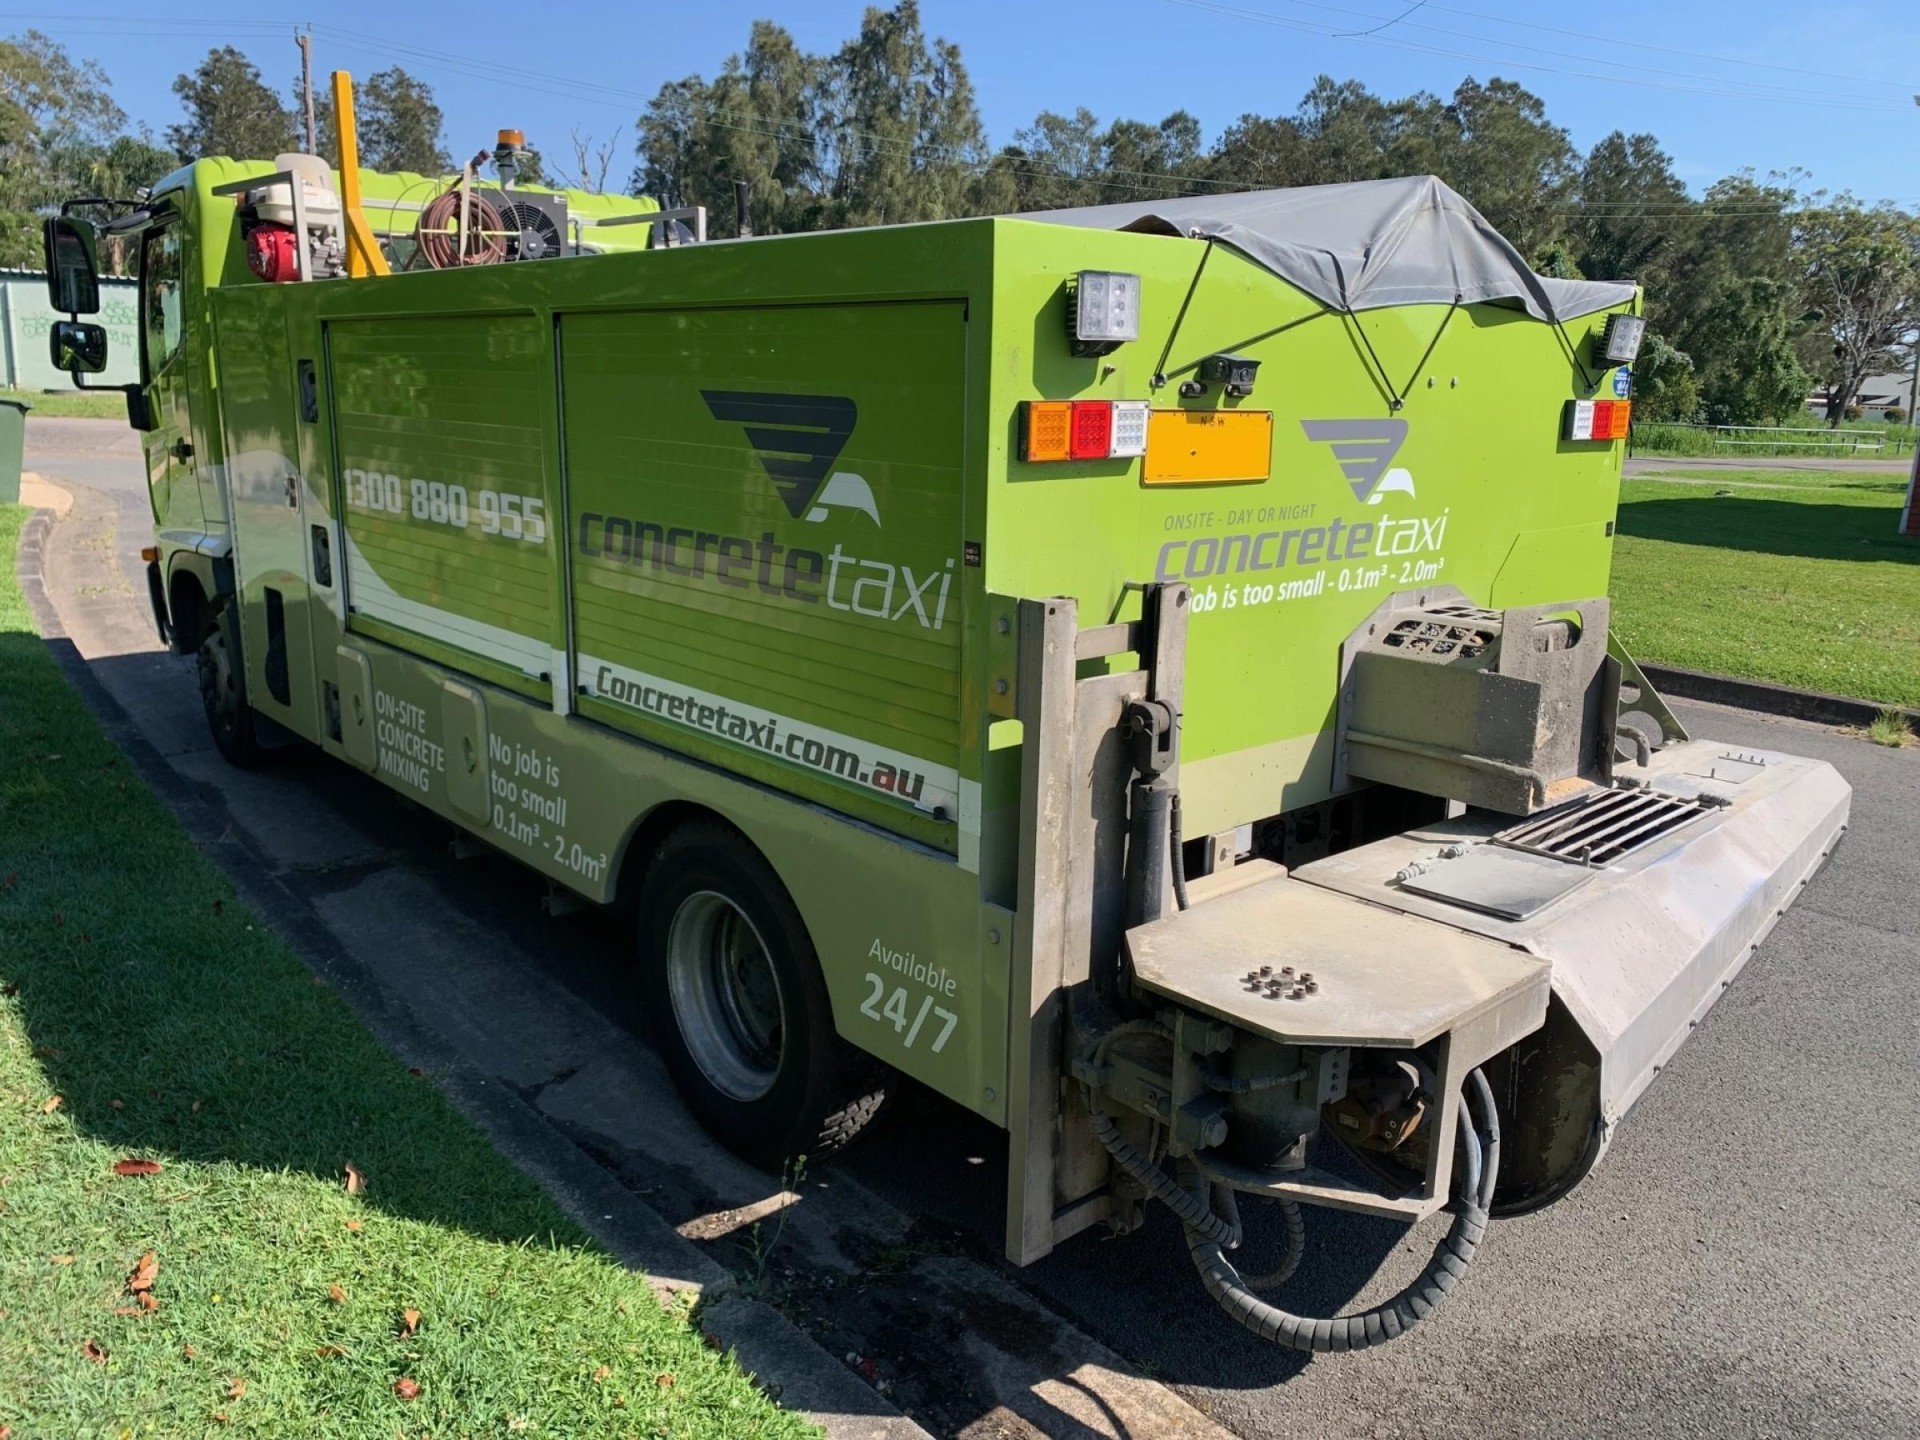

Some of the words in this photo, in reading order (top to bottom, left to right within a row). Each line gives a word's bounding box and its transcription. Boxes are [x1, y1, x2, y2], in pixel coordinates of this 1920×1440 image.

[410, 478, 469, 529] 880
[479, 489, 546, 544] 955
[1164, 511, 1215, 531] ONSITE
[1227, 508, 1255, 526] DAY
[1257, 506, 1275, 523] OR
[1277, 503, 1317, 521] NIGHT
[1222, 583, 1238, 609] is
[1243, 582, 1274, 607] too
[1276, 570, 1326, 601] small
[375, 690, 427, 734] ON-SITE
[595, 665, 925, 801] Concretetaxi.com.au
[377, 719, 445, 773] CONCRETE
[379, 746, 430, 793] MIXING
[489, 732, 512, 766] No
[514, 743, 541, 780] job
[545, 756, 560, 788] is
[491, 771, 518, 801] too
[521, 787, 568, 828] small
[868, 938, 957, 997] Available
[860, 972, 958, 1053] 24/7
